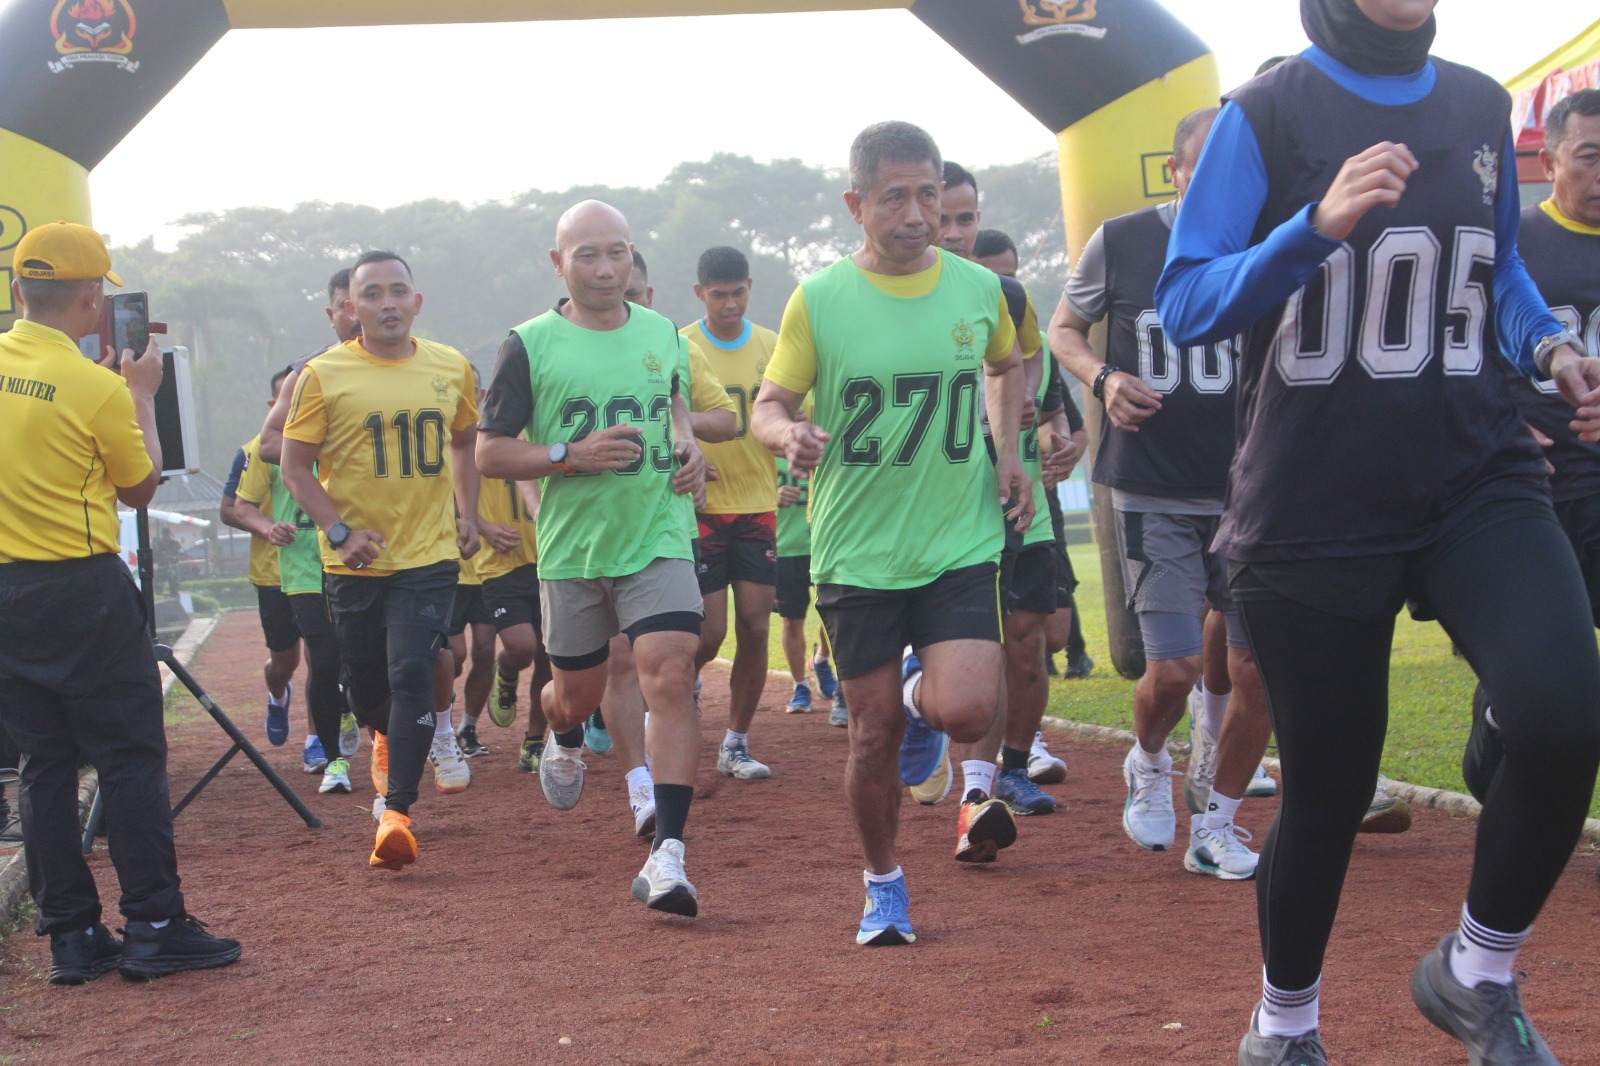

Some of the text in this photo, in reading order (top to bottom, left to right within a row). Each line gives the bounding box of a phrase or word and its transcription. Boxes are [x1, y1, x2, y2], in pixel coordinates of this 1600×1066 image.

[1275, 225, 1495, 386] 005
[5, 376, 57, 402] MILITER
[1135, 308, 1242, 394] 00
[363, 408, 446, 478] 110
[560, 394, 673, 478] 263
[841, 368, 979, 466] 270
